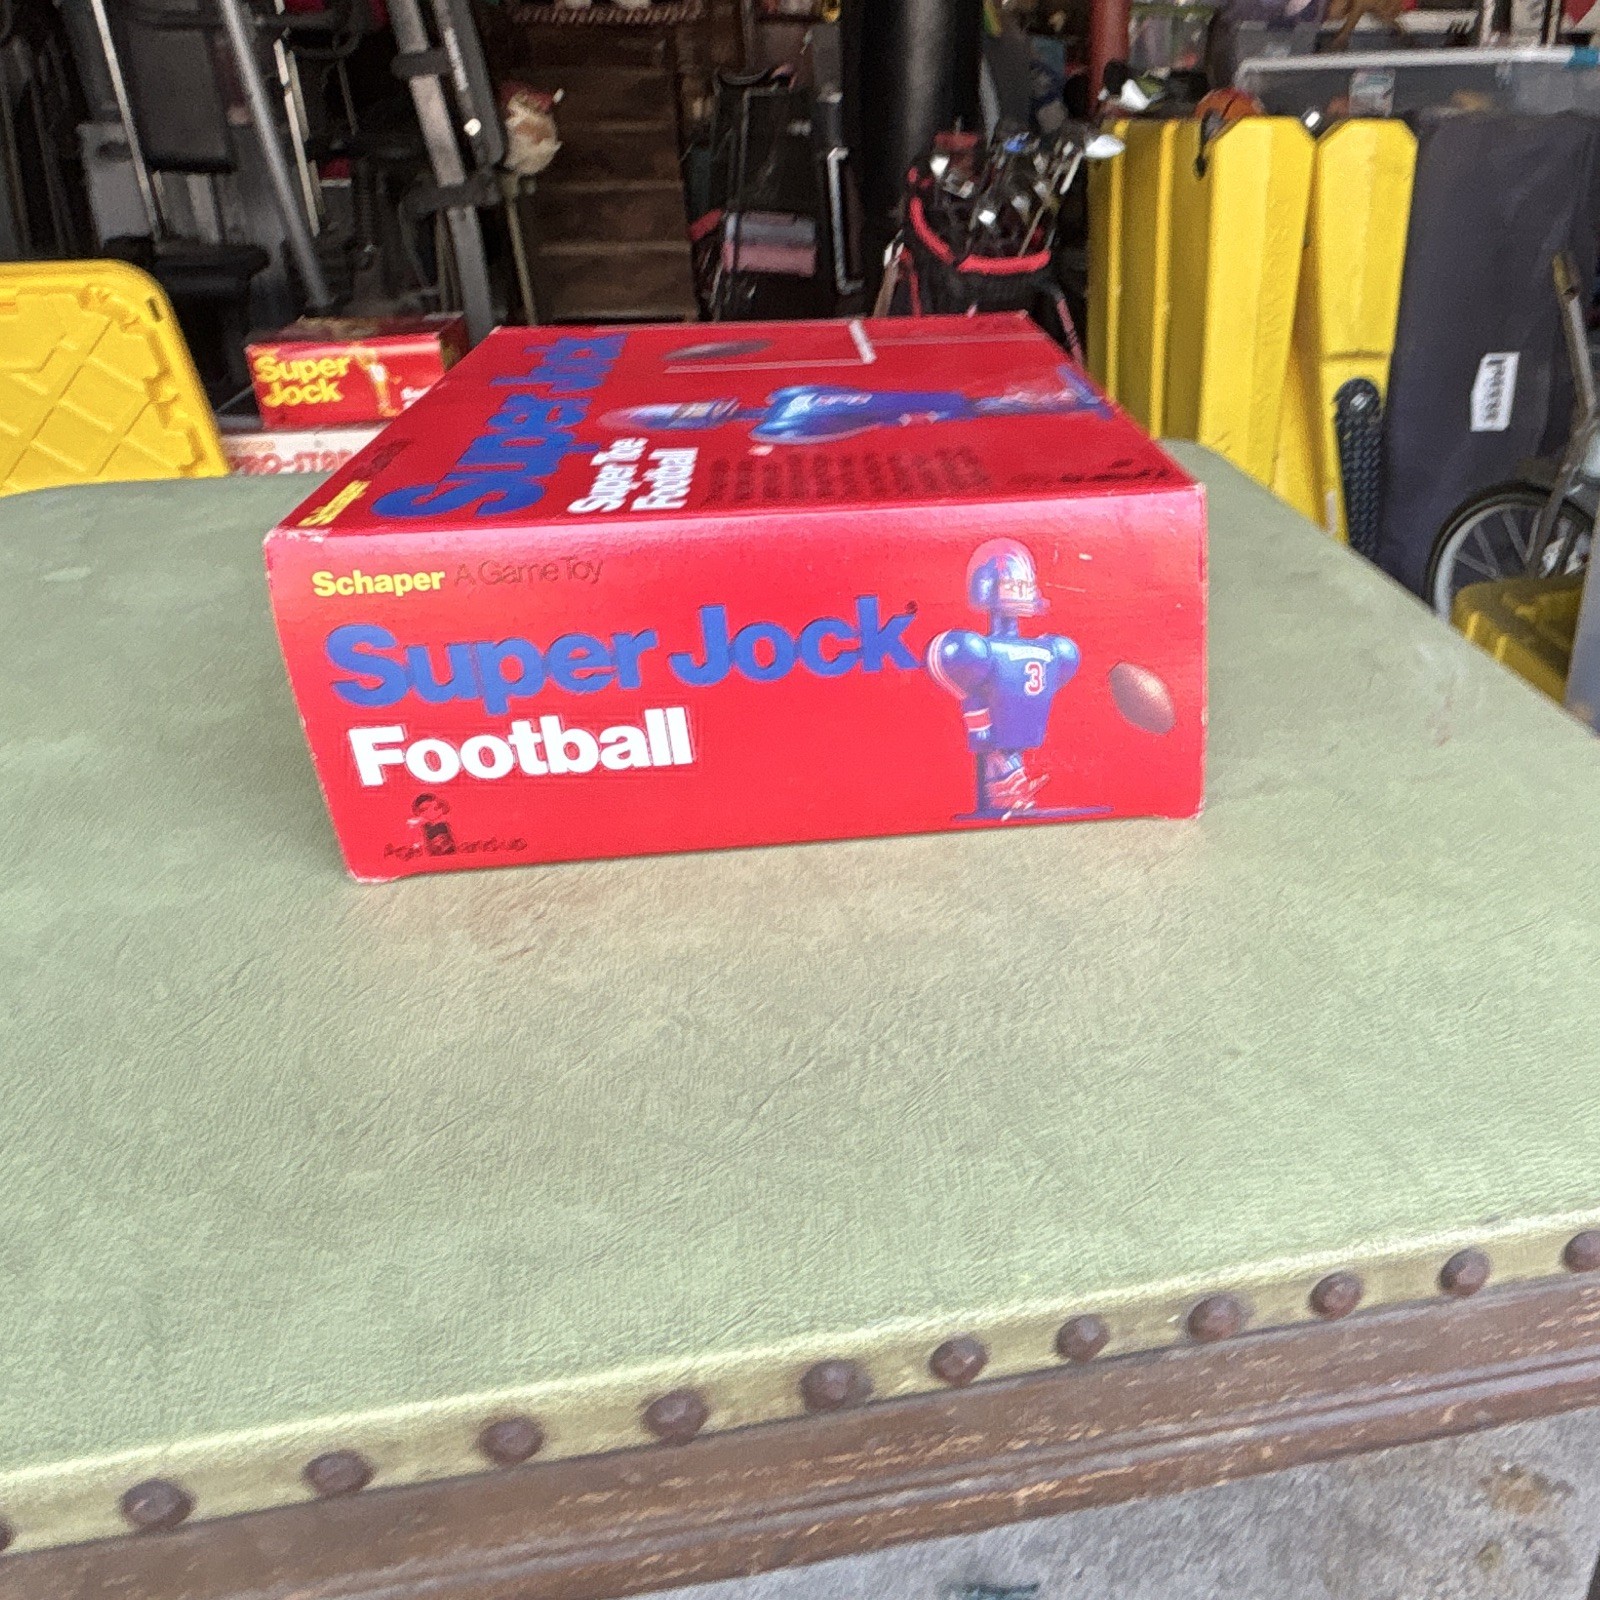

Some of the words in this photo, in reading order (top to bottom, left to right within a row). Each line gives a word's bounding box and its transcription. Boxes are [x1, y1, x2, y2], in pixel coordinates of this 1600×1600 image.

[253, 355, 351, 383] Super
[263, 378, 345, 408] Jock
[369, 394, 601, 519] Super
[488, 333, 629, 392] Jock
[590, 437, 650, 466] Toe
[567, 463, 642, 514] Super
[630, 447, 699, 512] Football
[311, 569, 446, 597] Schaper
[454, 563, 475, 586] A
[477, 560, 559, 586] Game
[560, 555, 603, 584] Toy
[326, 624, 657, 715] Super
[670, 595, 918, 686] Jock
[1024, 661, 1045, 696] 3
[347, 706, 694, 787] Football
